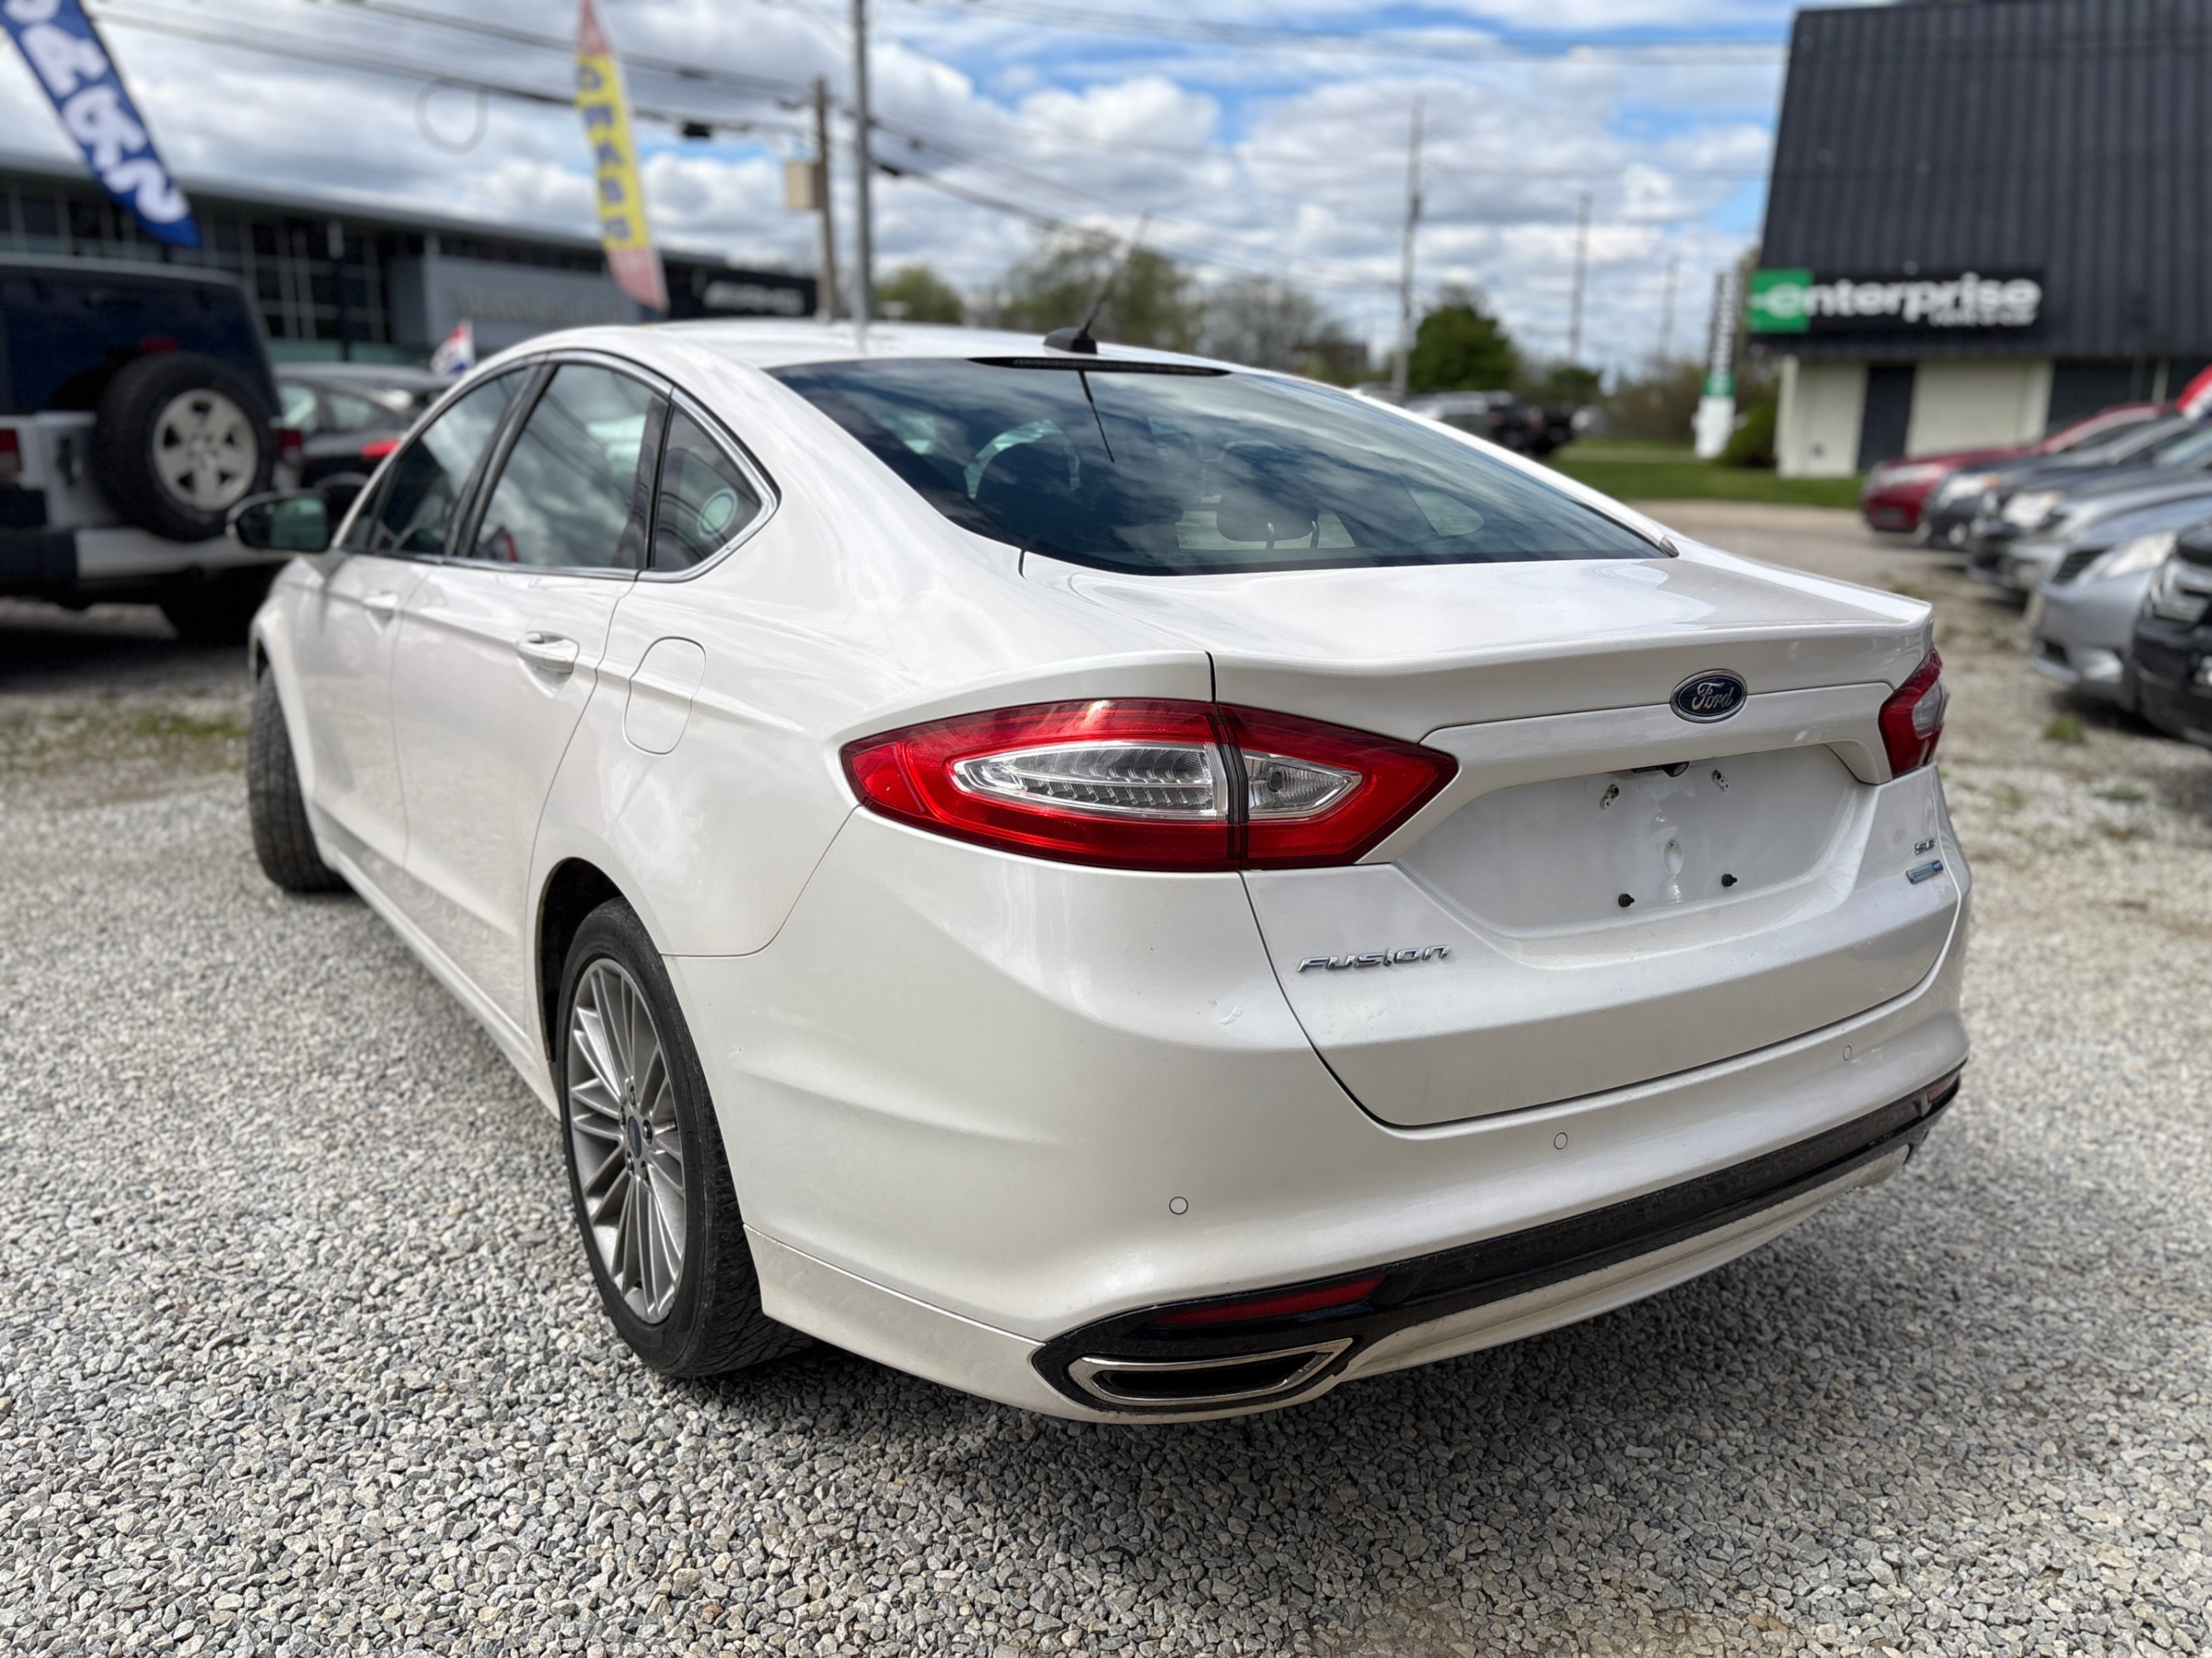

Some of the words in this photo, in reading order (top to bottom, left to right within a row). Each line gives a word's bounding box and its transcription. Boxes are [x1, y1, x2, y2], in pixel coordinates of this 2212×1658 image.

[1750, 272, 2042, 323] enterprise
[1690, 681, 1735, 711] Ford
[1914, 836, 1936, 856] SE
